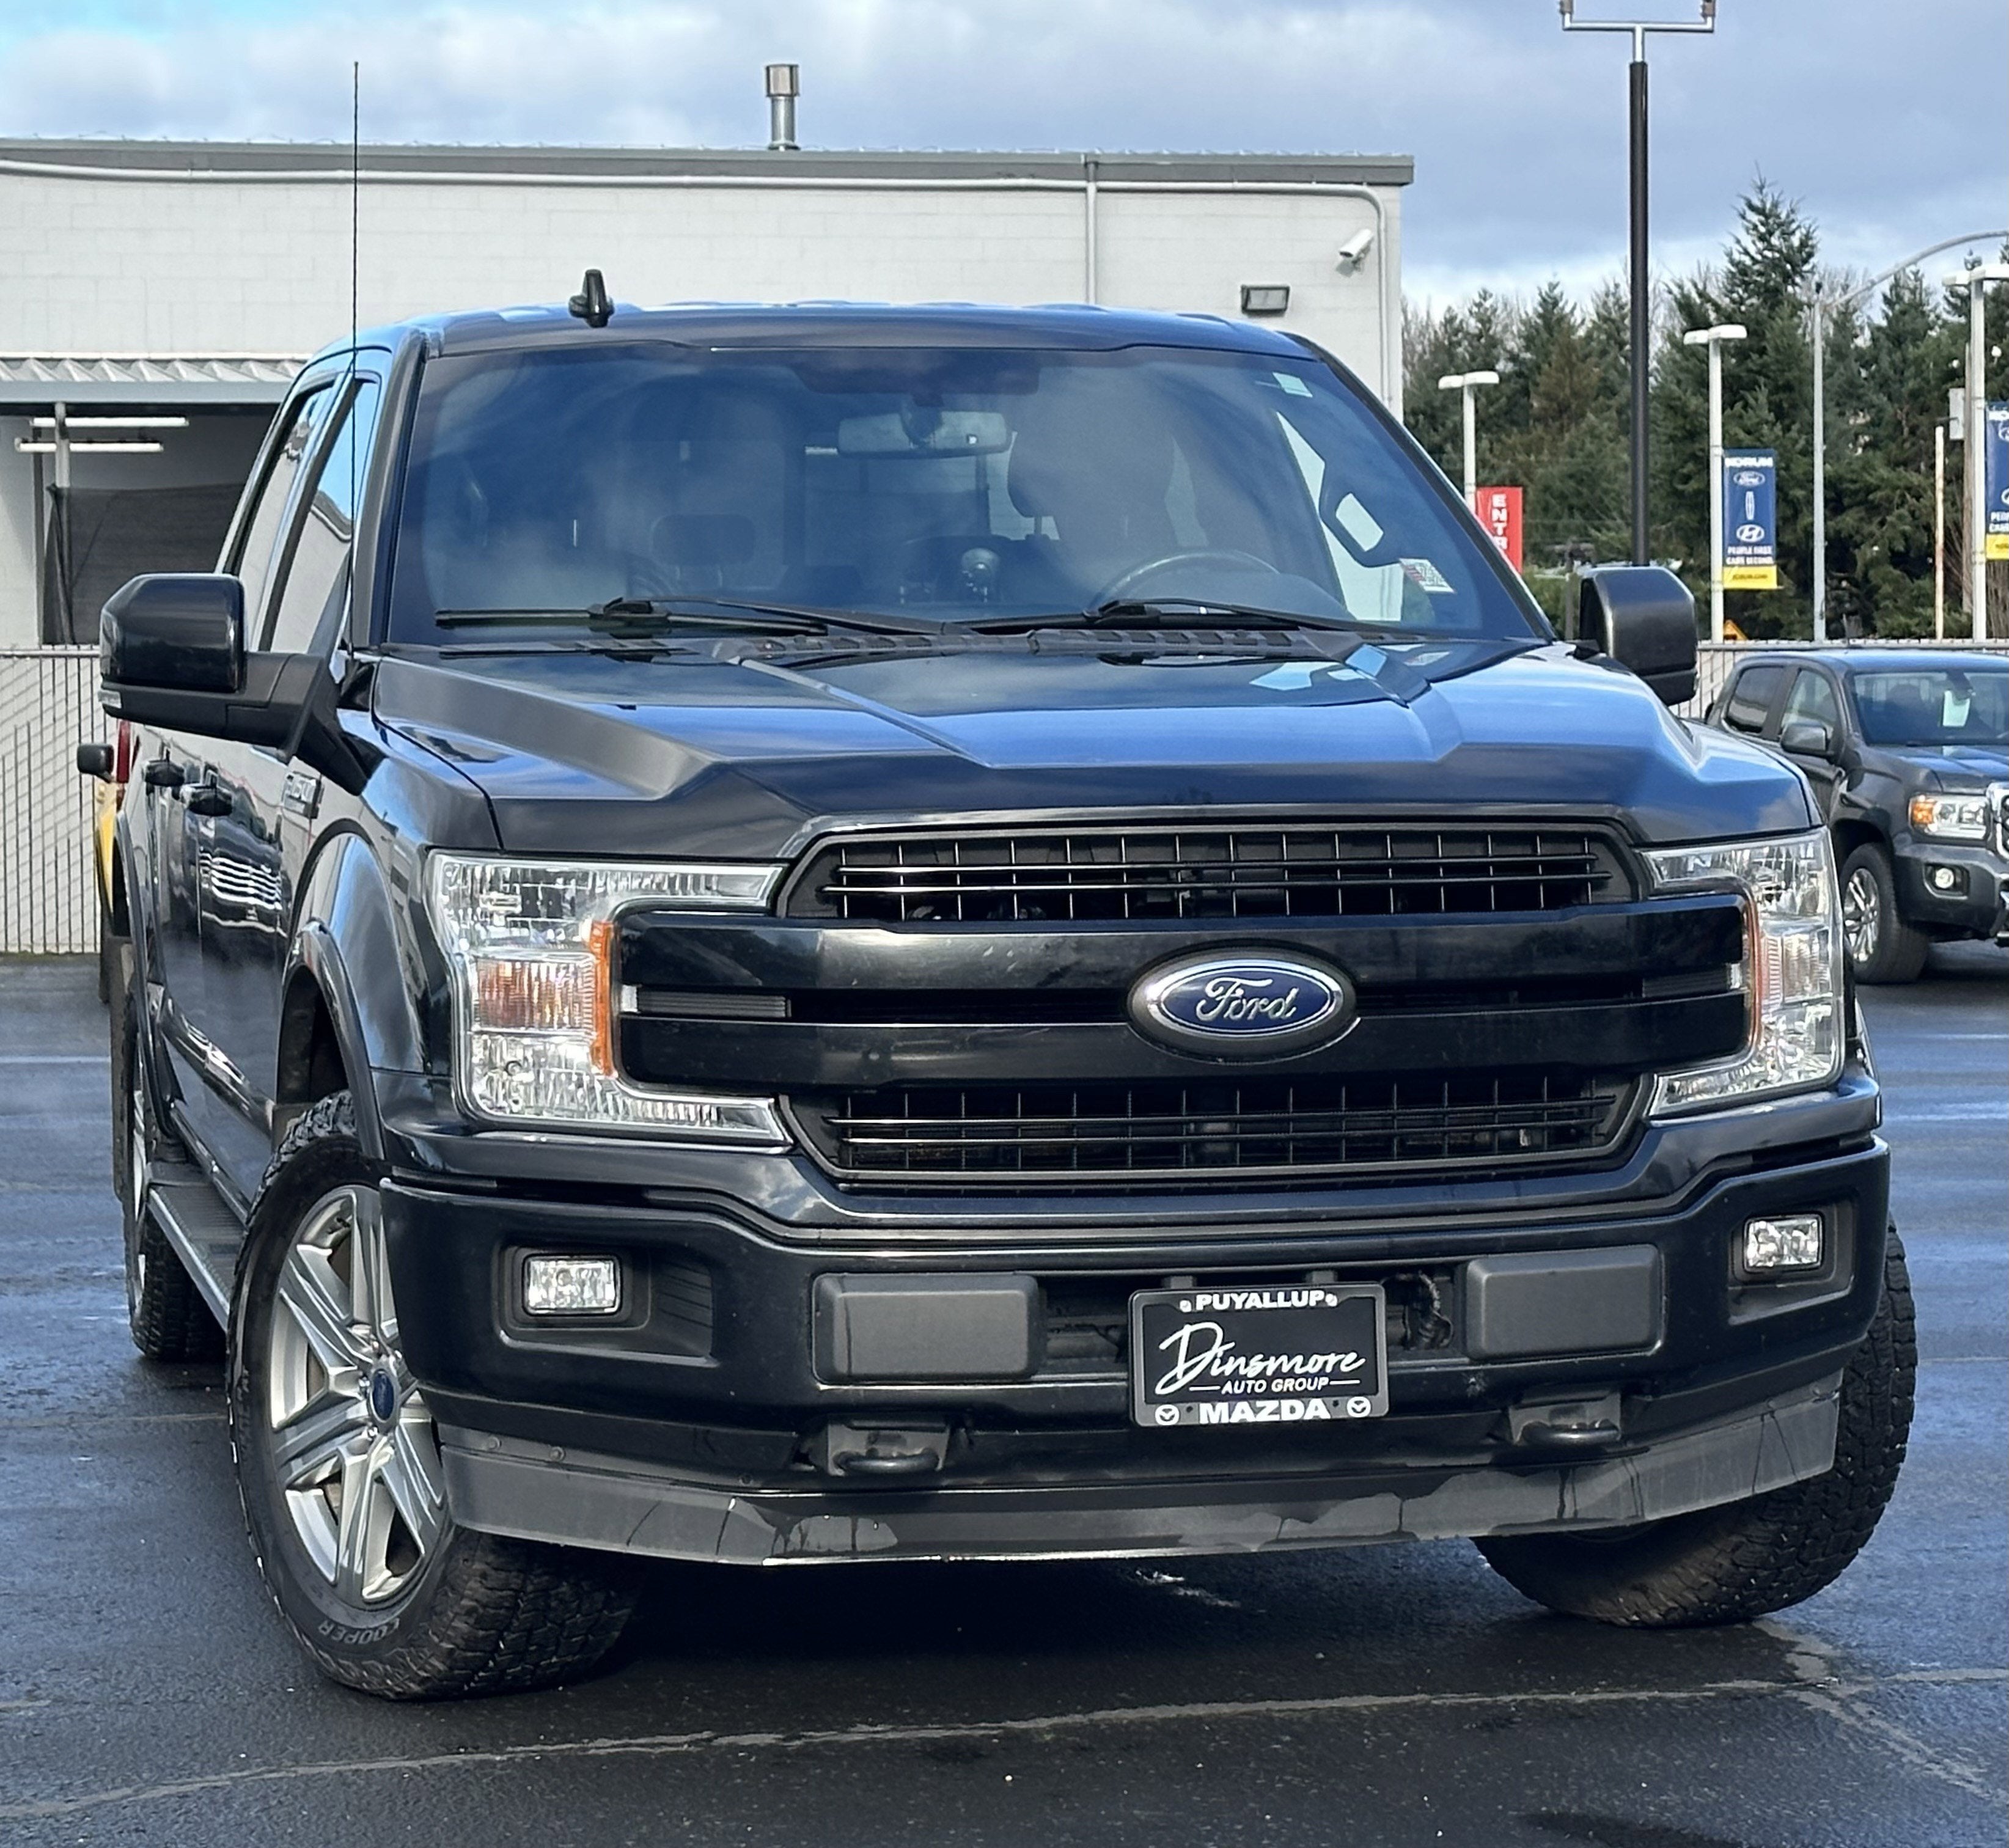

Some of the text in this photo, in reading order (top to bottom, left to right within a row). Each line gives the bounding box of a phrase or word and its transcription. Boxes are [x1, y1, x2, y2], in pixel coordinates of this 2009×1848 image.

[1196, 977, 1299, 1021] Ford
[1195, 1289, 1324, 1311] PUYALLUP
[1155, 1322, 1365, 1395] Dinsmore
[1221, 1377, 1329, 1394] AUTO GROUP
[1199, 1398, 1331, 1424] MAZDA
[317, 1617, 400, 1645] COOPER
